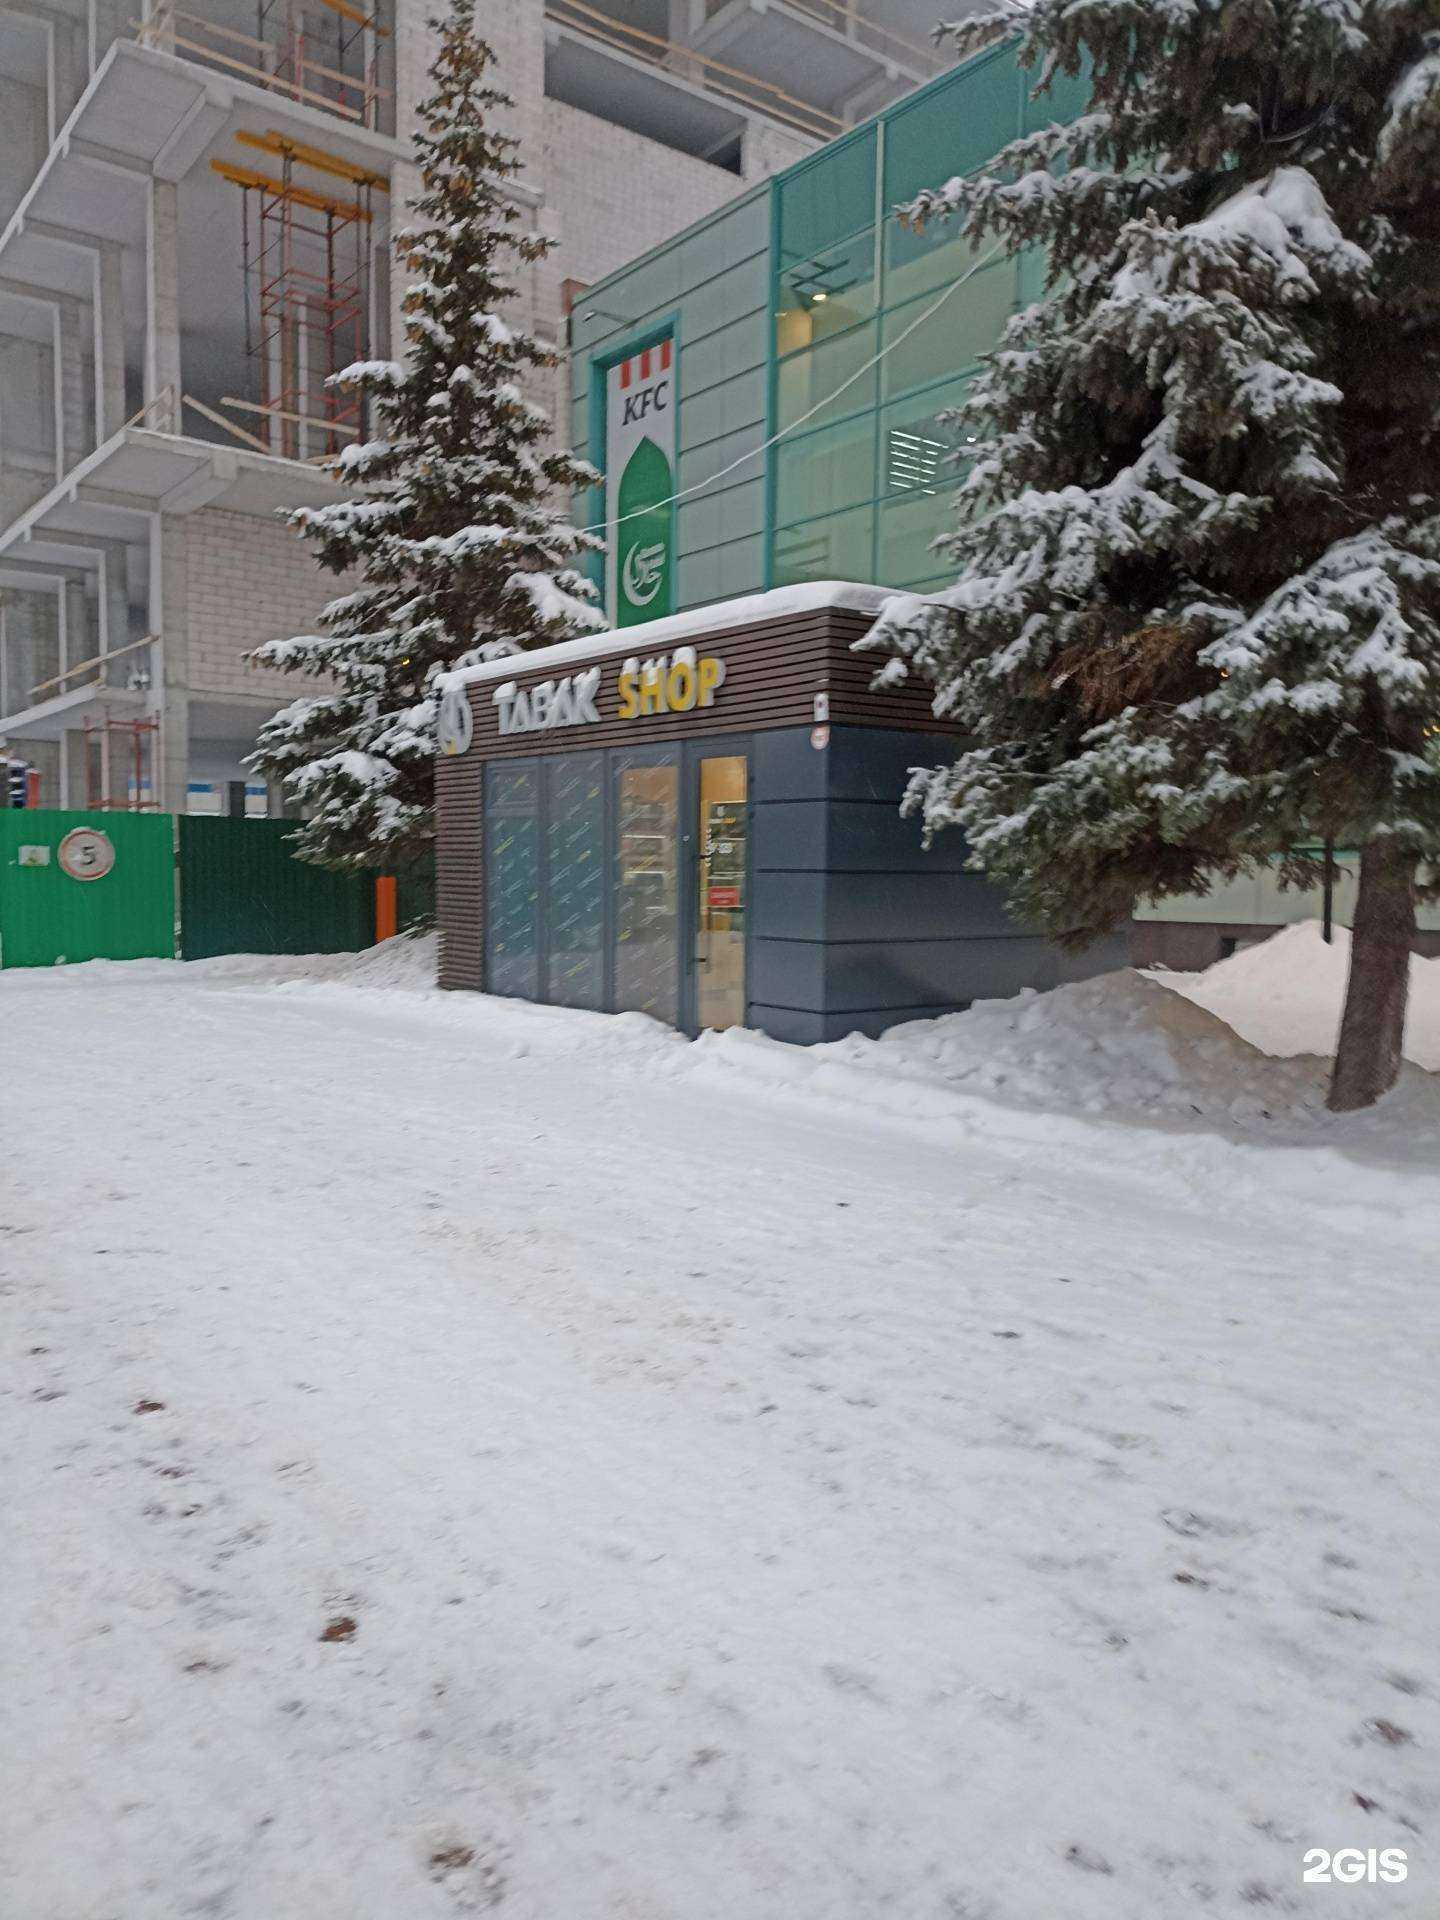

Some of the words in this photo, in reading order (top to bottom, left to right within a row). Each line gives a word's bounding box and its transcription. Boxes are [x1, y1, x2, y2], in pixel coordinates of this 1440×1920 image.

[621, 380, 669, 426] KFC
[492, 667, 601, 735] TABAK
[618, 655, 726, 719] SHOP
[81, 846, 96, 865] 5
